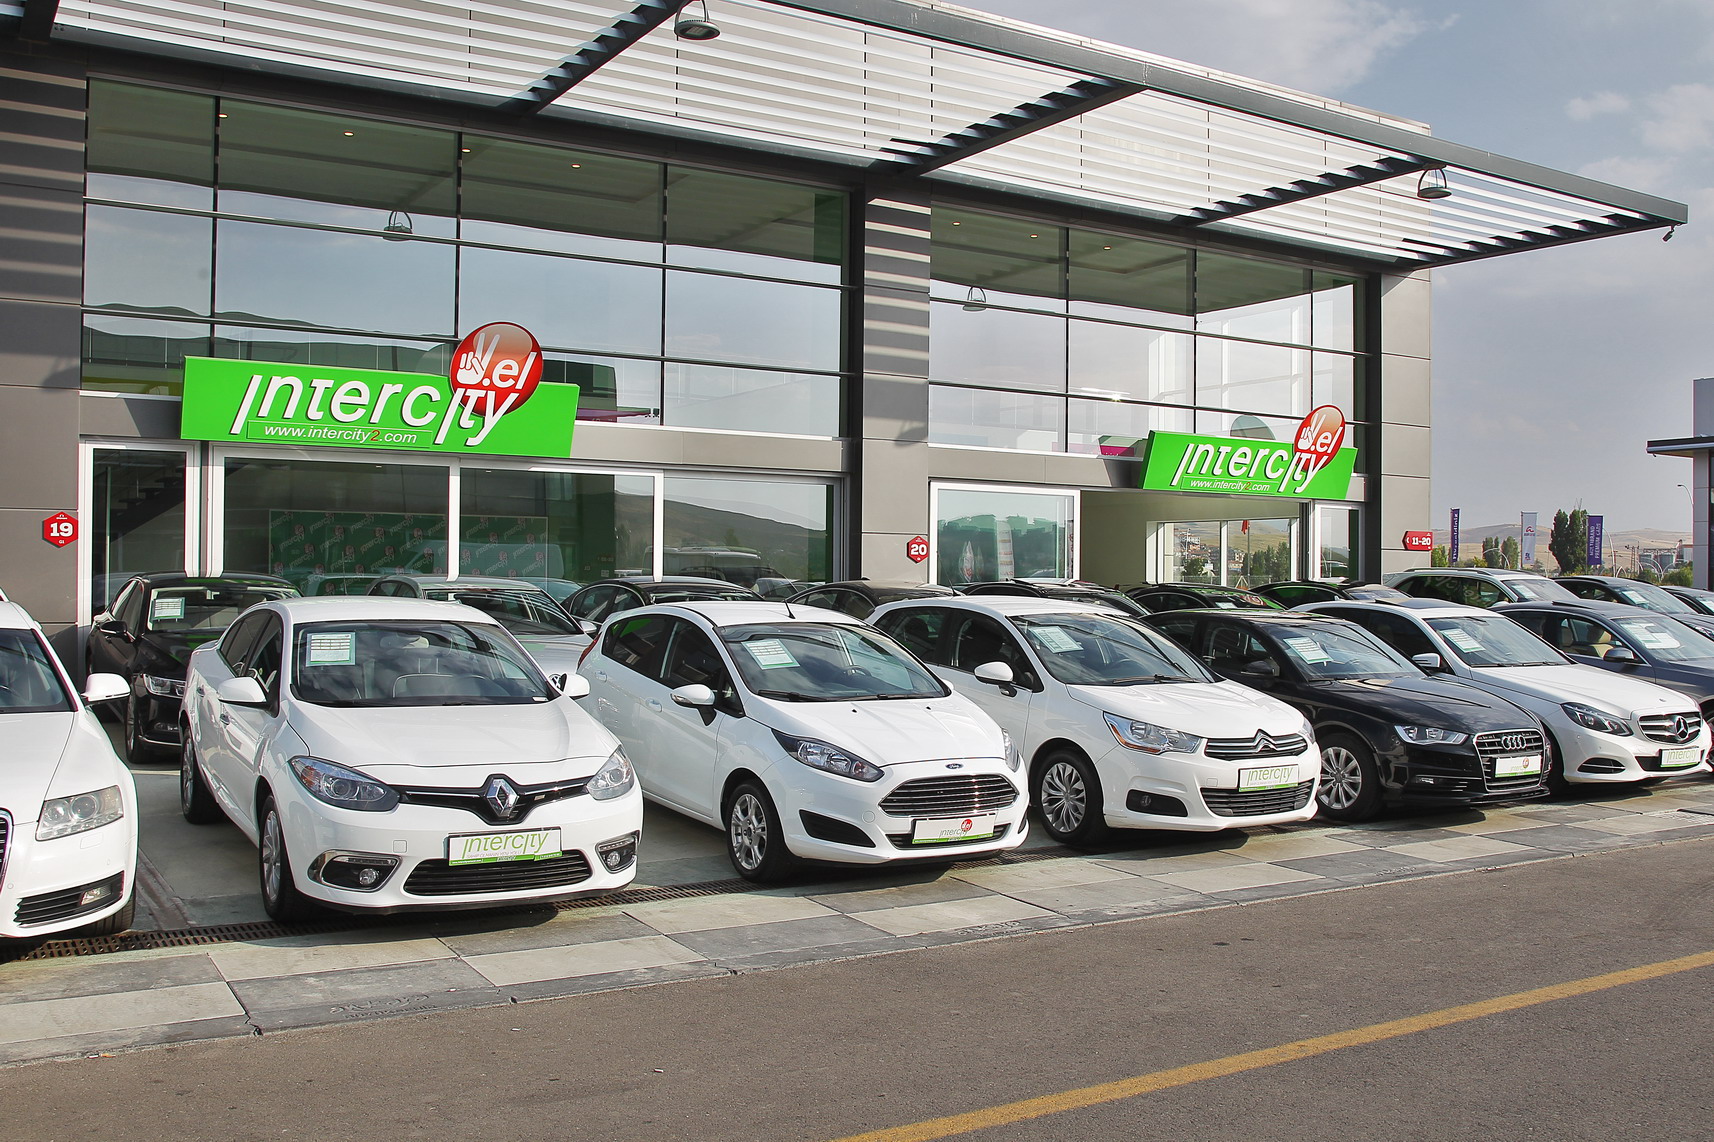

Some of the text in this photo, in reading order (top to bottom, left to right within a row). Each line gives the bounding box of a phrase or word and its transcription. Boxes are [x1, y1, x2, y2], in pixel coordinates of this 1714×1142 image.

[263, 424, 417, 444] www.intercity2.com
[1190, 479, 1270, 492] www.intercity2.com
[50, 521, 74, 537] 19
[1411, 536, 1431, 546] 11-20
[910, 543, 927, 556] 20
